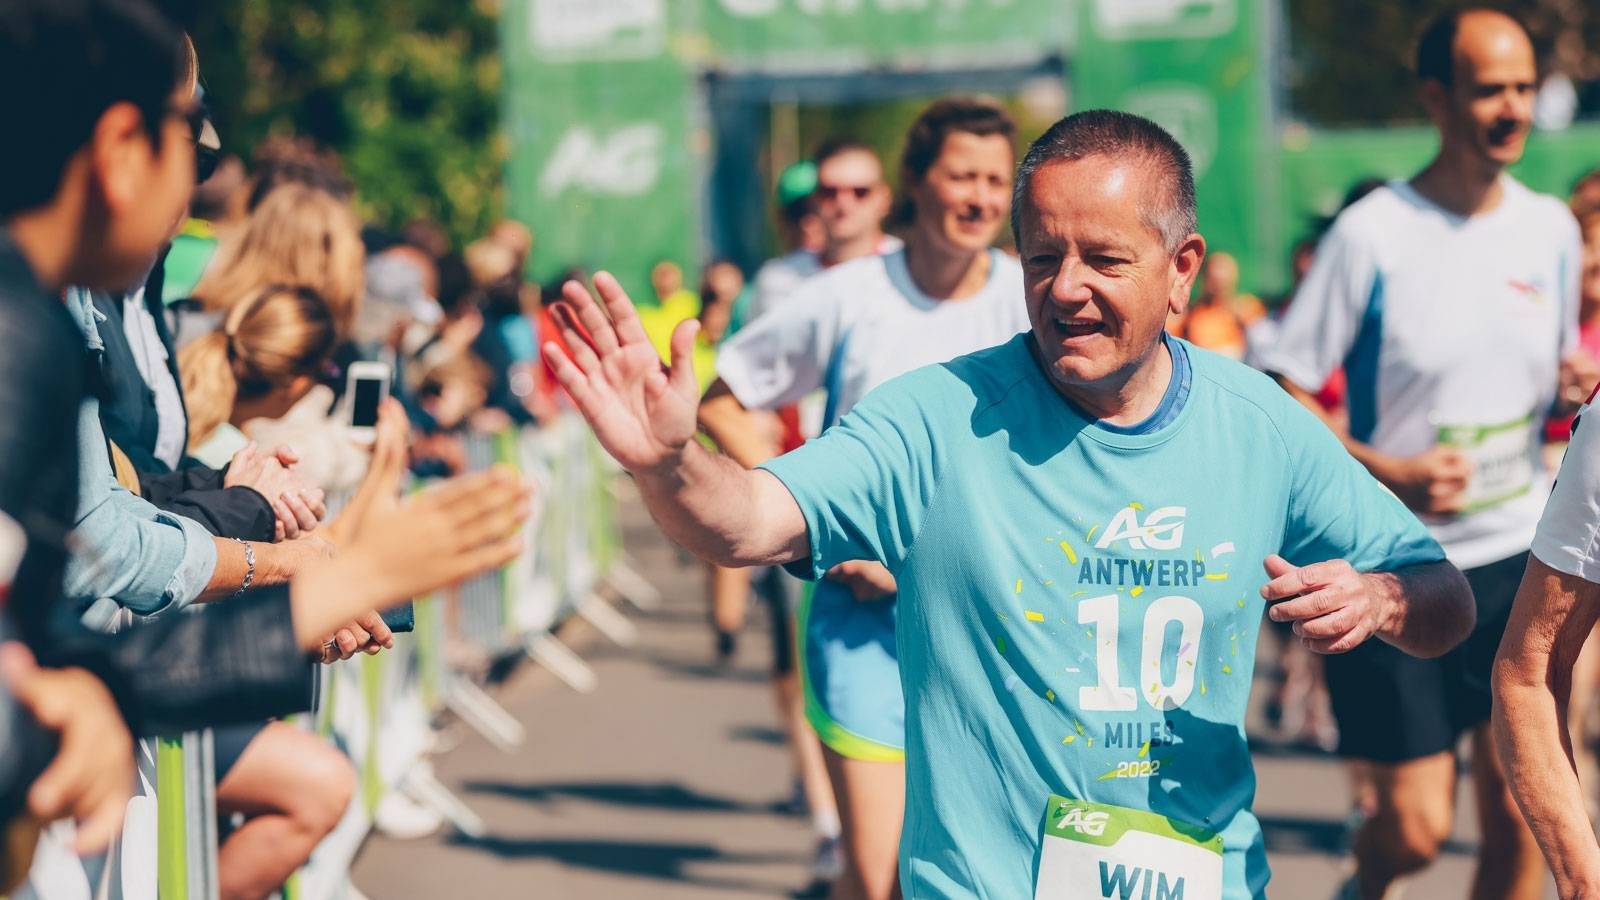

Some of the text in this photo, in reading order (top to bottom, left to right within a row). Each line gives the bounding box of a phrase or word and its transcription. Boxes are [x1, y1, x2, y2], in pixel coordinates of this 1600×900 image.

[540, 123, 665, 197] AG
[1095, 506, 1186, 550] AG
[1079, 557, 1206, 587] ANTWERP
[1078, 594, 1204, 711] 10
[1105, 719, 1175, 749] MILES
[1116, 760, 1161, 778] 2022
[1056, 808, 1110, 836] AG
[1098, 861, 1186, 900] WIM
